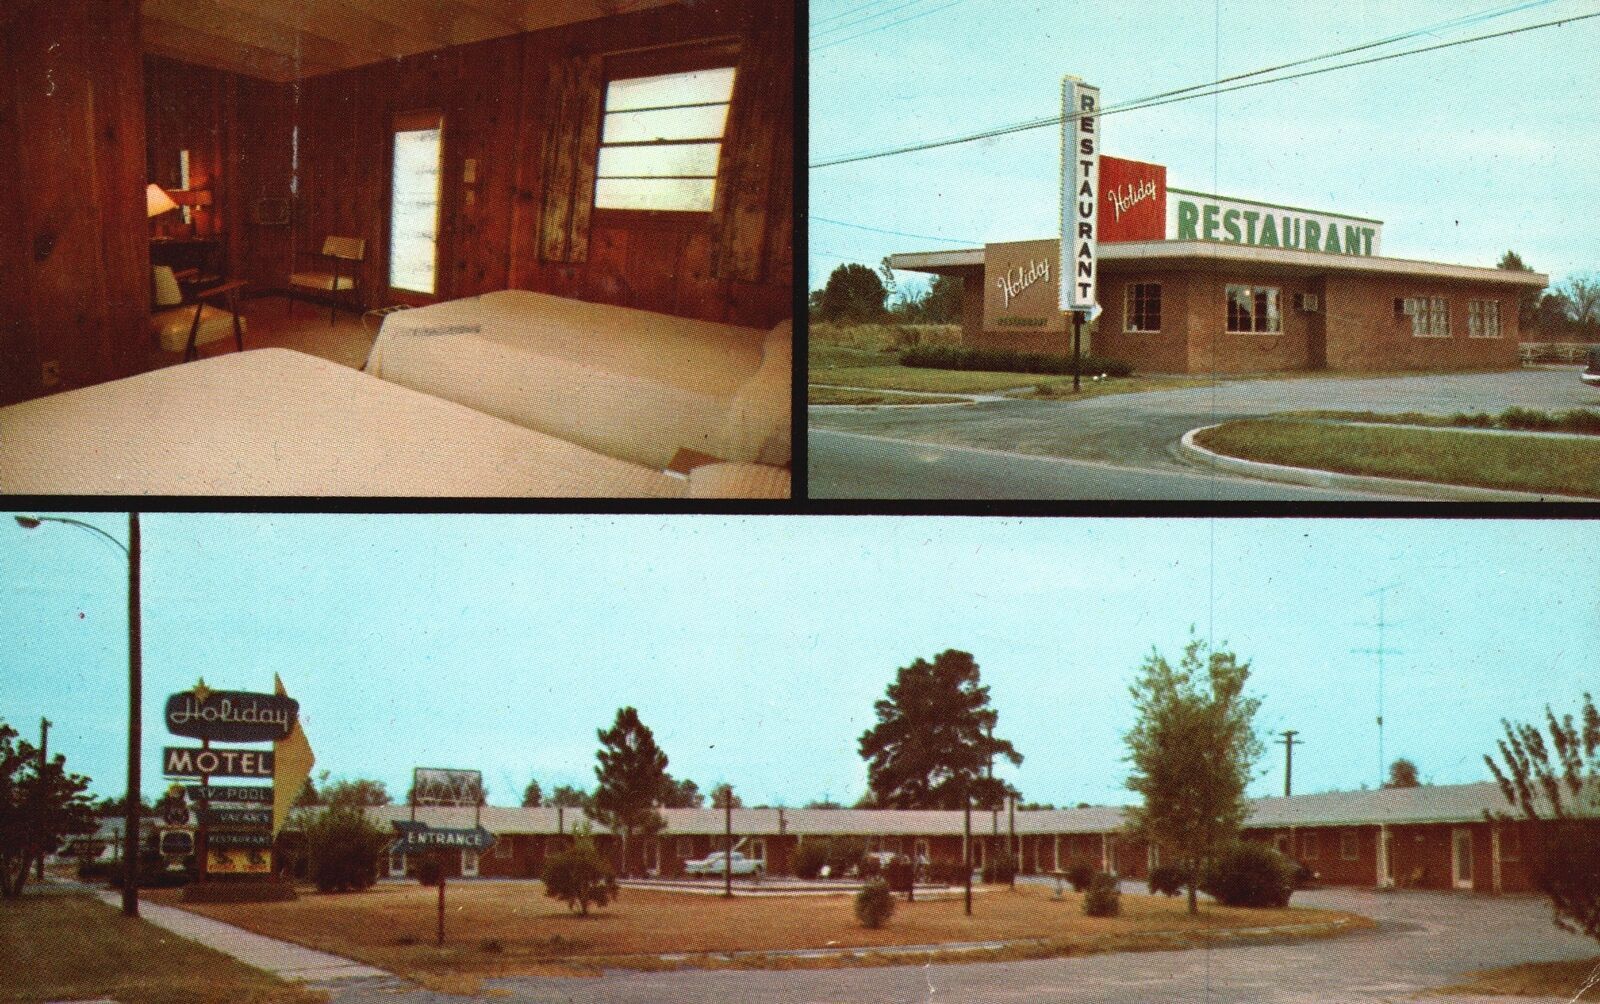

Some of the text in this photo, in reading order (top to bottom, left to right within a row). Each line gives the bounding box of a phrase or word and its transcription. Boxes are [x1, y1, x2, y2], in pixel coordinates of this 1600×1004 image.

[1078, 94, 1094, 298] RESTAURANT
[1108, 179, 1157, 223] Holiday
[1178, 200, 1375, 256] RESTAURANT
[997, 257, 1050, 308] Holiday
[169, 698, 289, 732] Holiday
[167, 751, 271, 774] MOTEL
[227, 788, 270, 800] POOL
[407, 831, 482, 846] ENTRANCE
